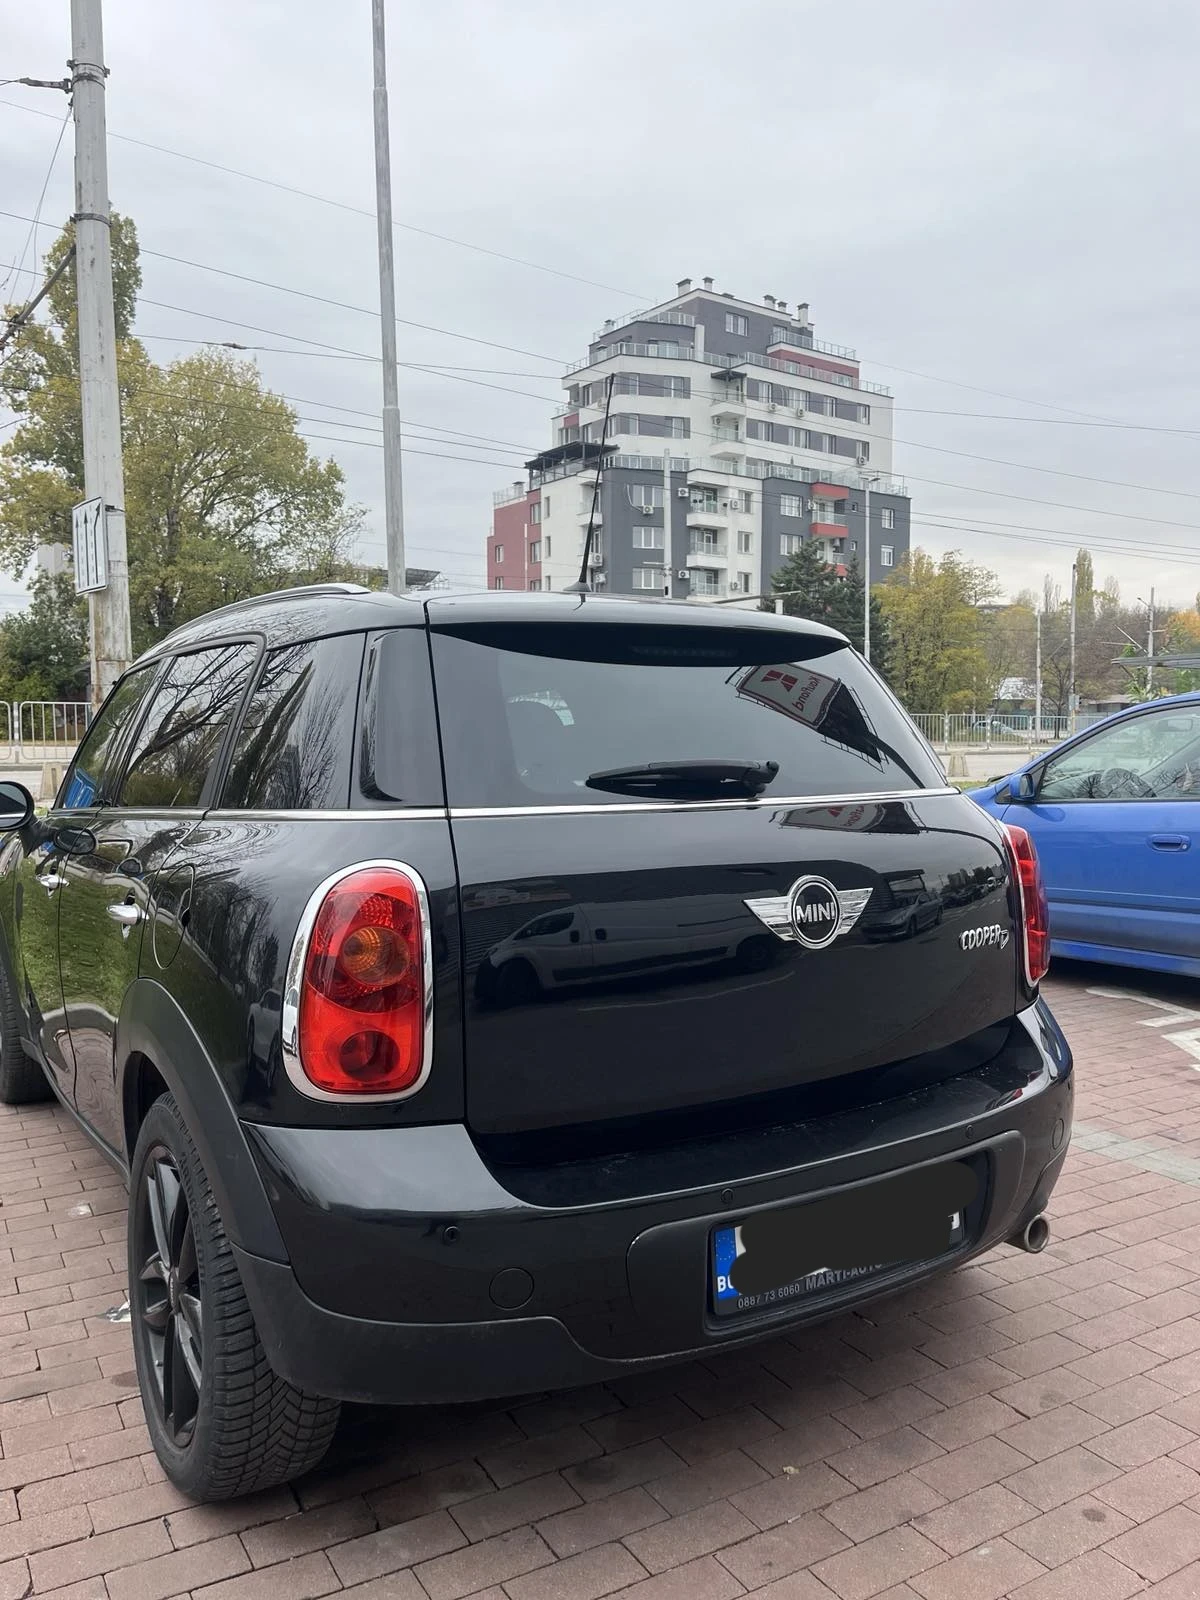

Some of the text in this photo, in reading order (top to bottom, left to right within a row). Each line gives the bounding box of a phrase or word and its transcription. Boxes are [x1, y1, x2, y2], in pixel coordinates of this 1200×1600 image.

[796, 902, 835, 923] MINI
[962, 924, 1000, 950] COOPER
[738, 1264, 882, 1309] 0887 73 6060 MARTI-AU
